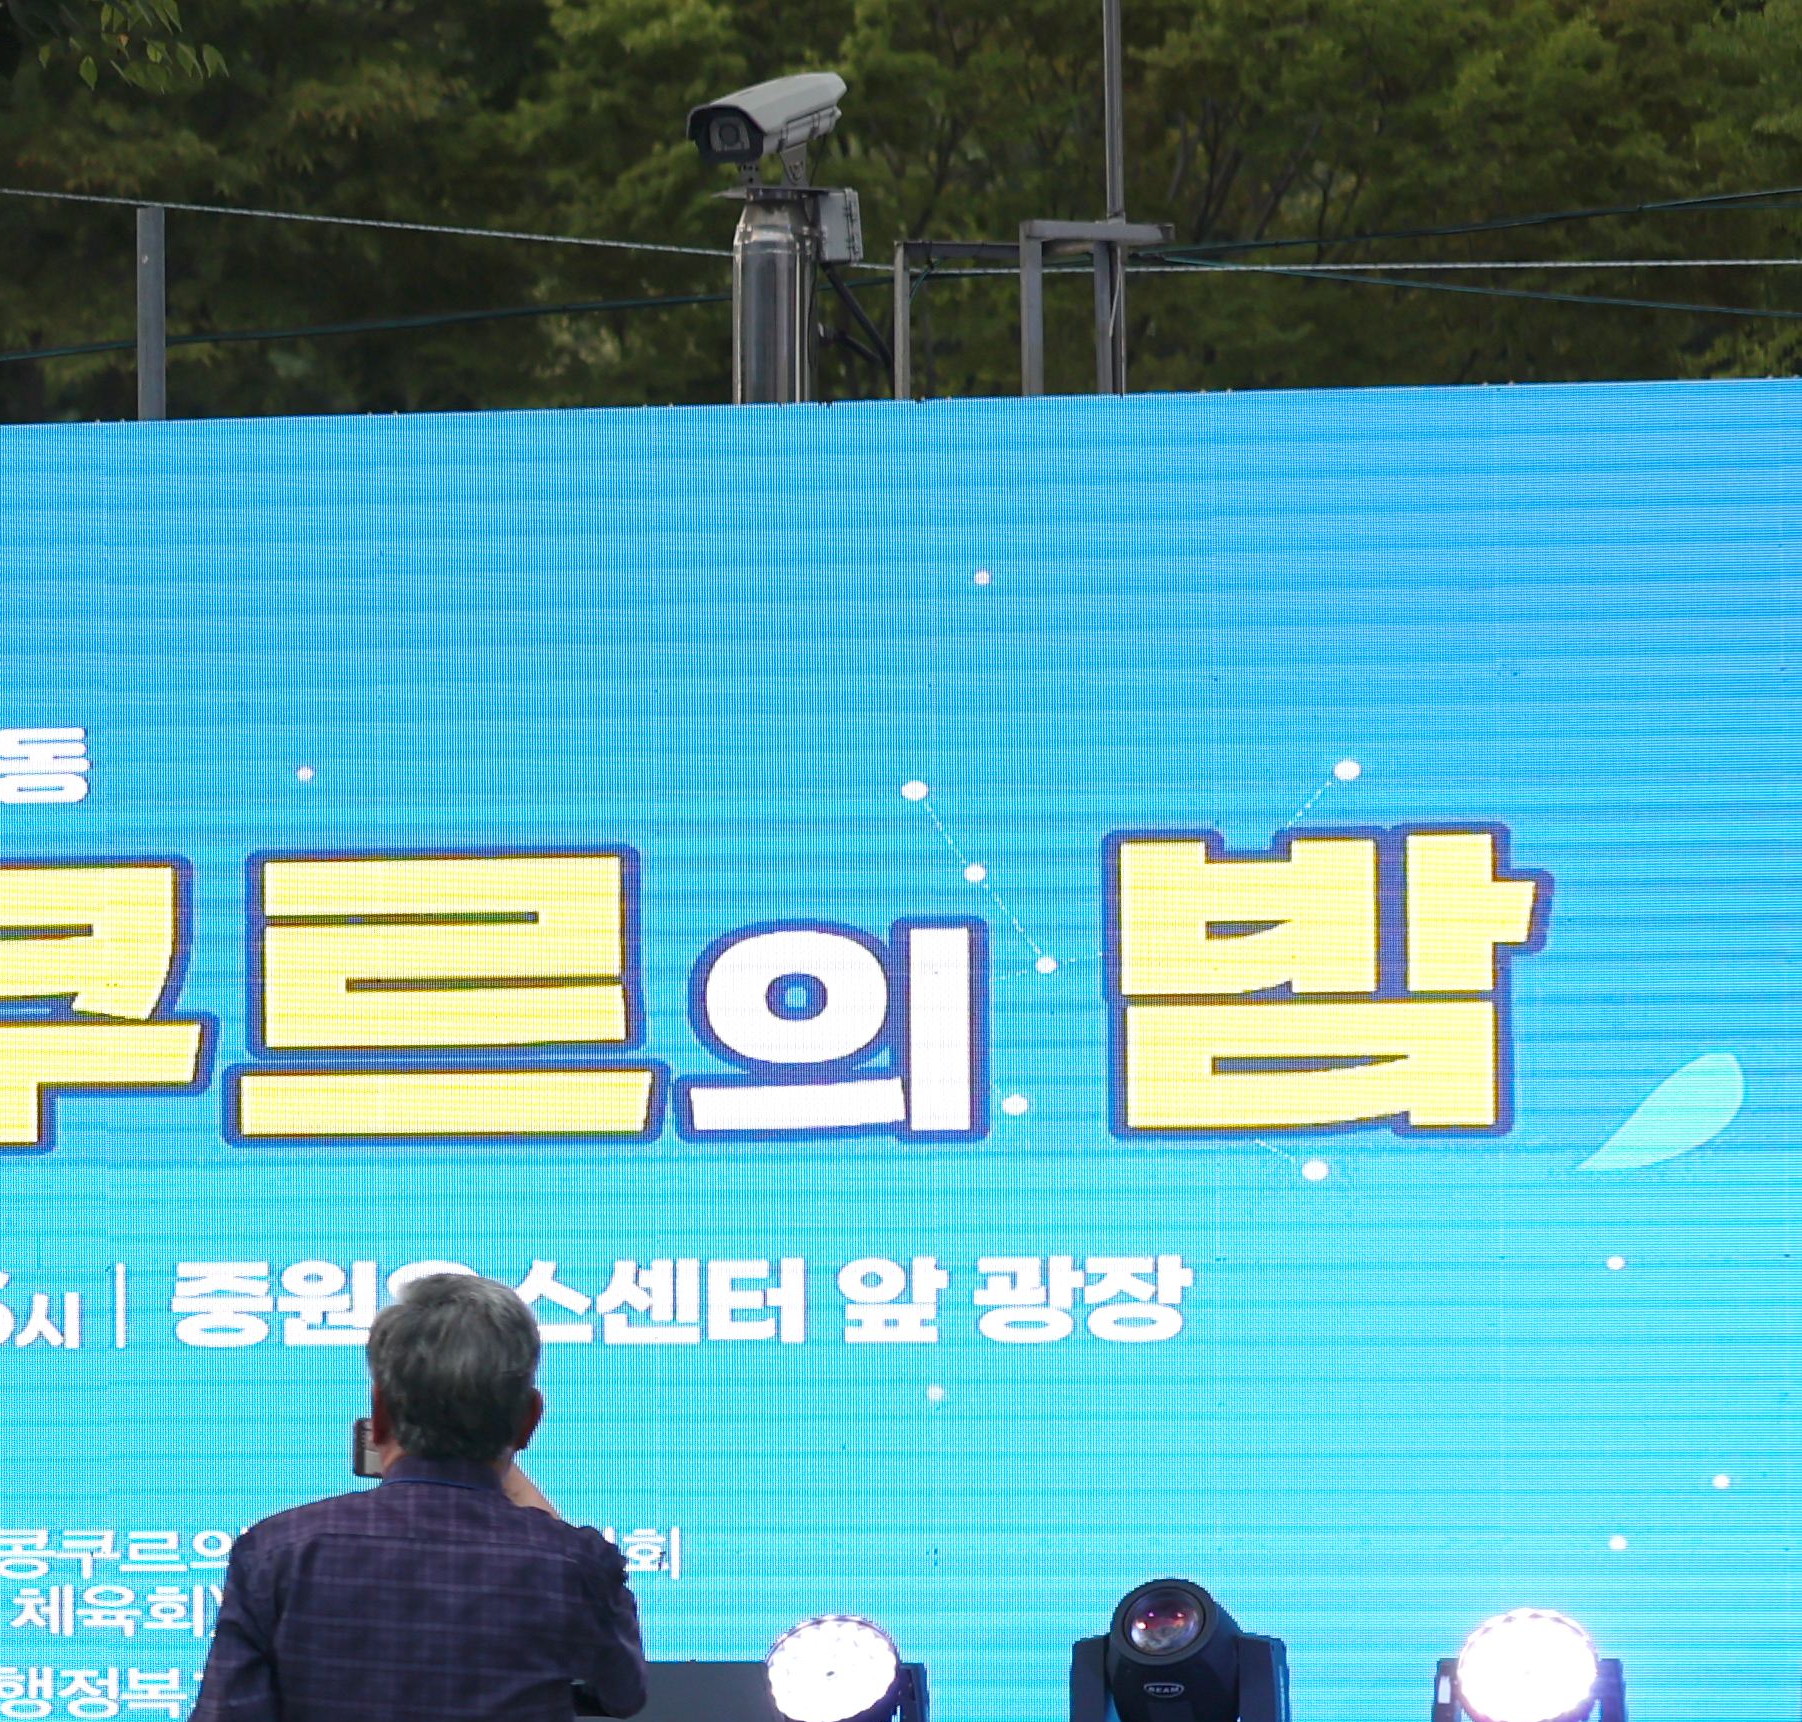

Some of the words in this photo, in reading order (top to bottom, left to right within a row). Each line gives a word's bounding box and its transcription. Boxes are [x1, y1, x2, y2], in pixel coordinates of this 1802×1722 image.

[1102, 821, 1554, 1138] 밤
[172, 1256, 806, 1347] 중원스센터
[837, 1255, 949, 1344] 앞
[973, 1254, 1194, 1345] 광장
